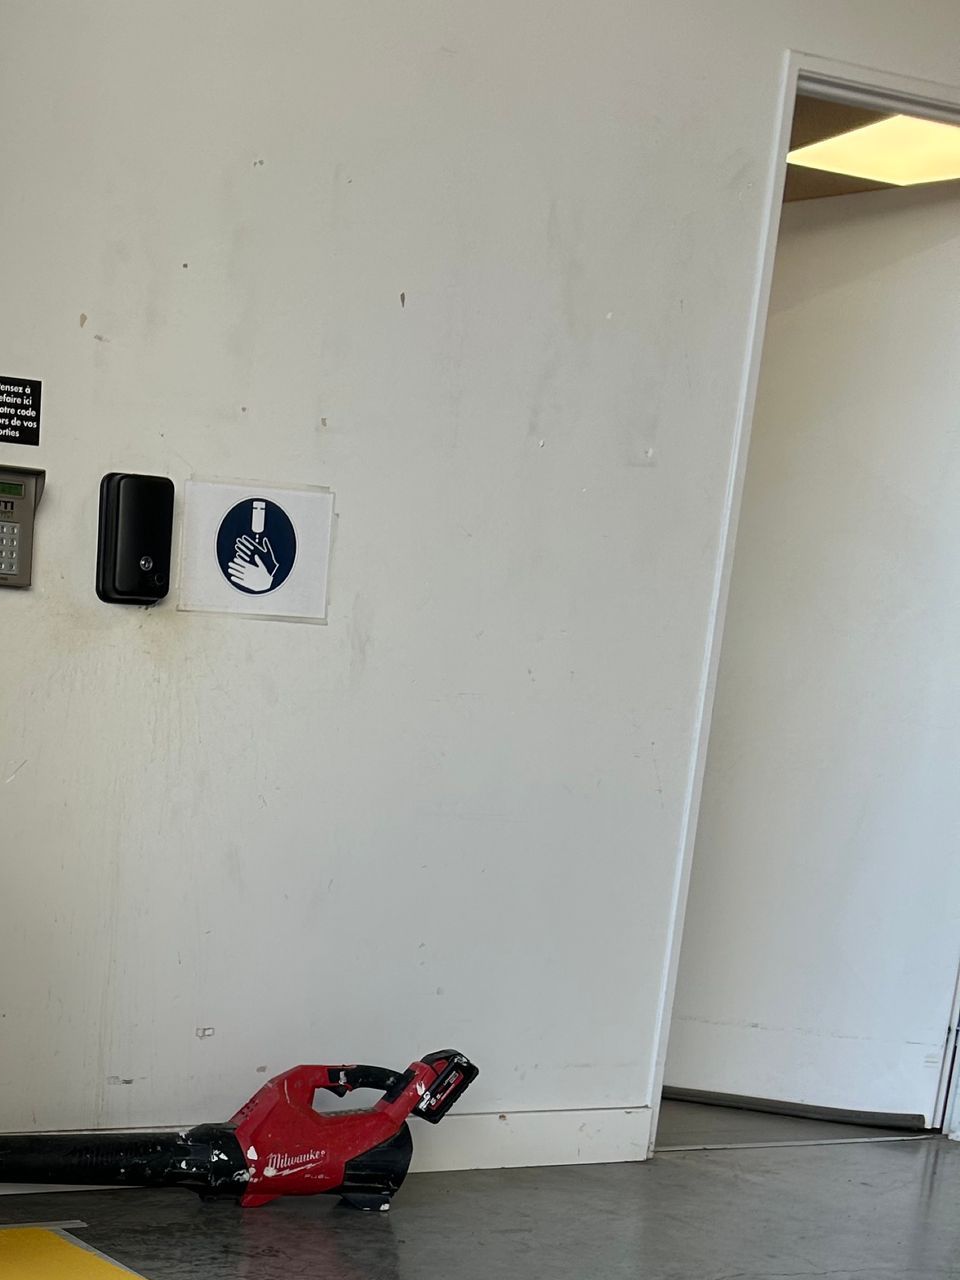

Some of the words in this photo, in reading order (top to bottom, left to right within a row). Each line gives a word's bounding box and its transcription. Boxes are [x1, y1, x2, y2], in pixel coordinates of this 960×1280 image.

[25, 385, 31, 394] à
[23, 395, 32, 405] ici
[17, 407, 36, 417] code
[11, 417, 21, 426] de
[23, 420, 37, 428] vos
